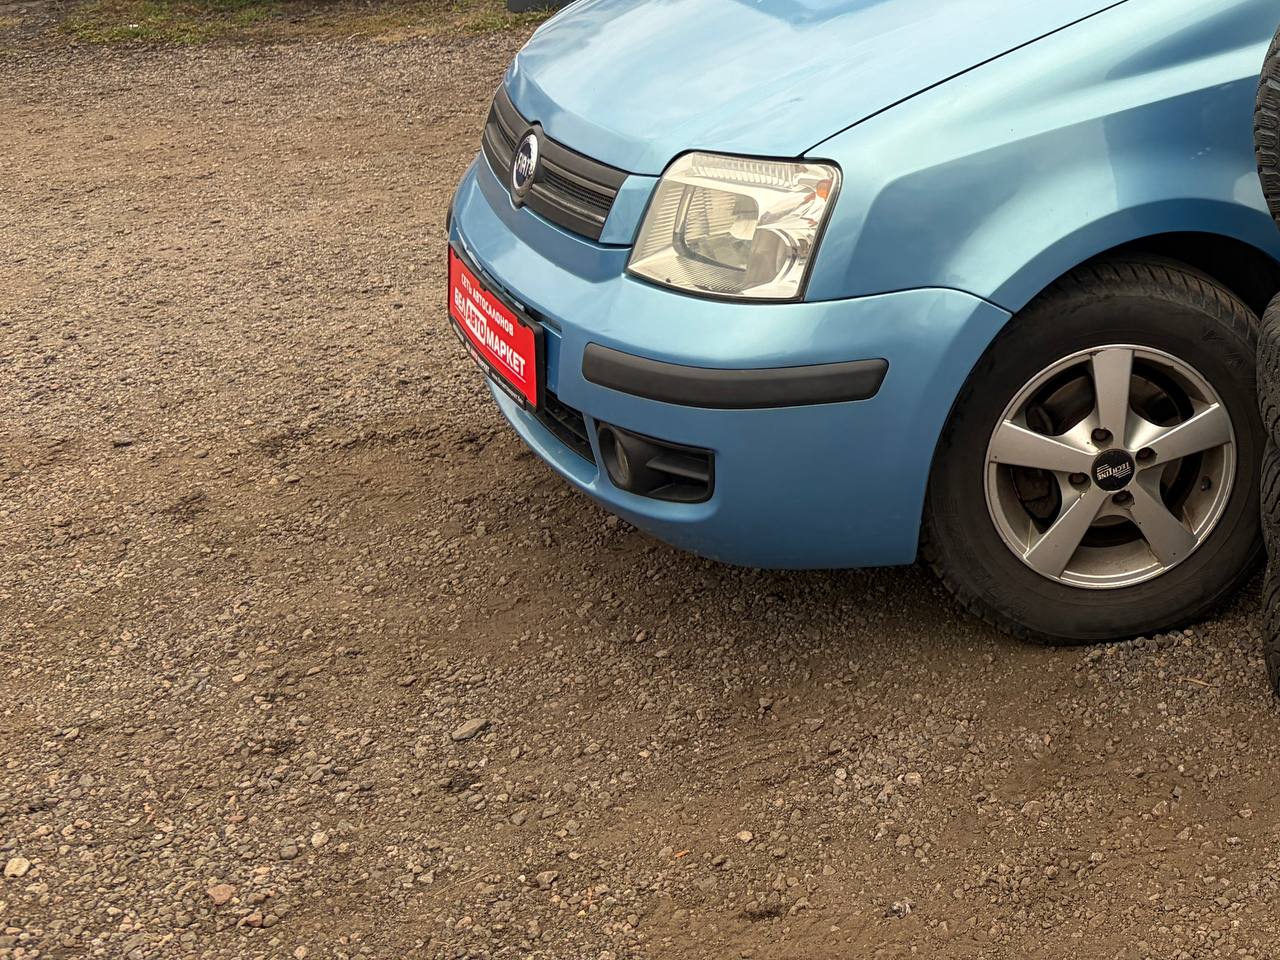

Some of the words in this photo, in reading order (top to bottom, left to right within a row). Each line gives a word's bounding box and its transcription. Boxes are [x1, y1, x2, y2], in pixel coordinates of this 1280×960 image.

[454, 287, 466, 319] БЕЛ
[466, 299, 487, 343] АВТО
[486, 329, 526, 378] МАРКЕТ
[461, 272, 473, 296] СЕТЬ
[472, 291, 514, 337] АВТОСАЛОНОВ
